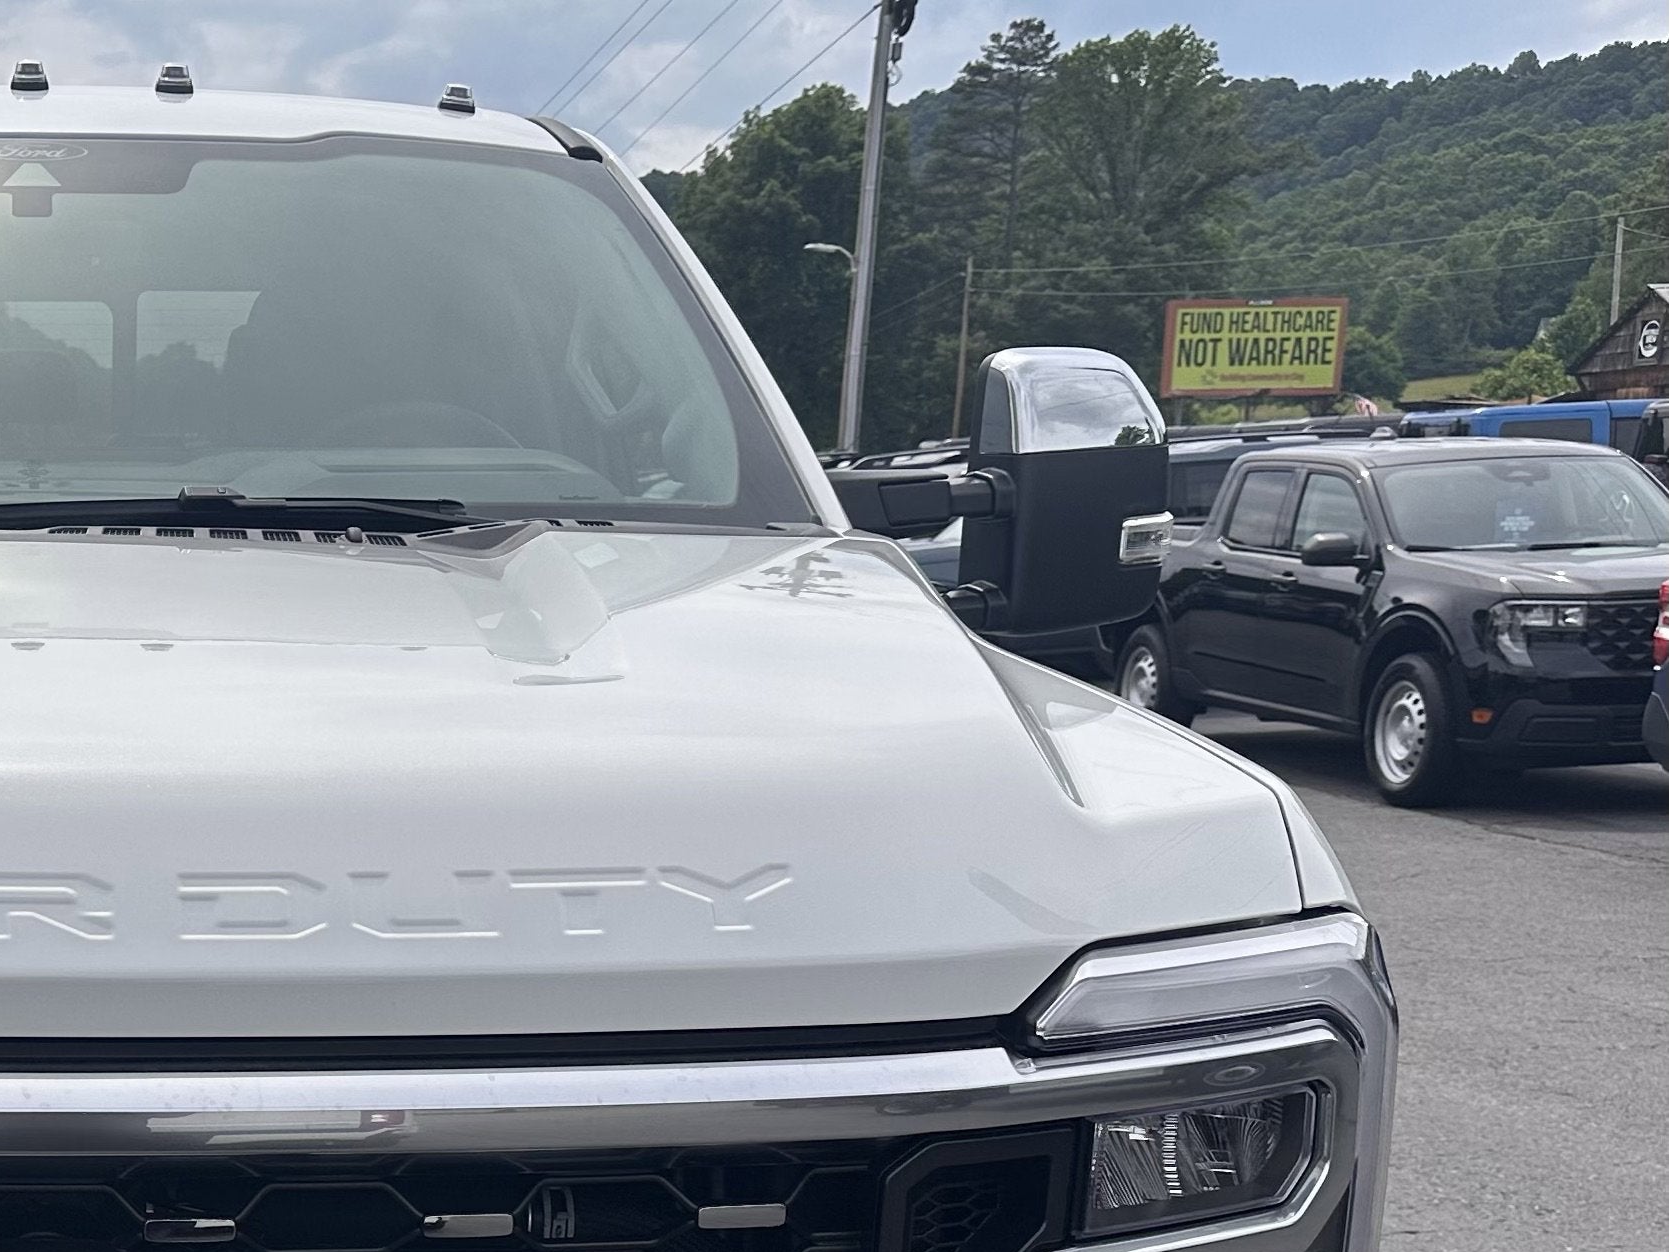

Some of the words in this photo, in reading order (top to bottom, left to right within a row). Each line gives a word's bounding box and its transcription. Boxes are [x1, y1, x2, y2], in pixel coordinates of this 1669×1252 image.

[1180, 311, 1224, 334] FUND
[1229, 310, 1336, 333] HEALTHCARE
[1177, 337, 1222, 367] NOT
[1228, 337, 1334, 366] WARFARE
[176, 863, 793, 939] DUTY
